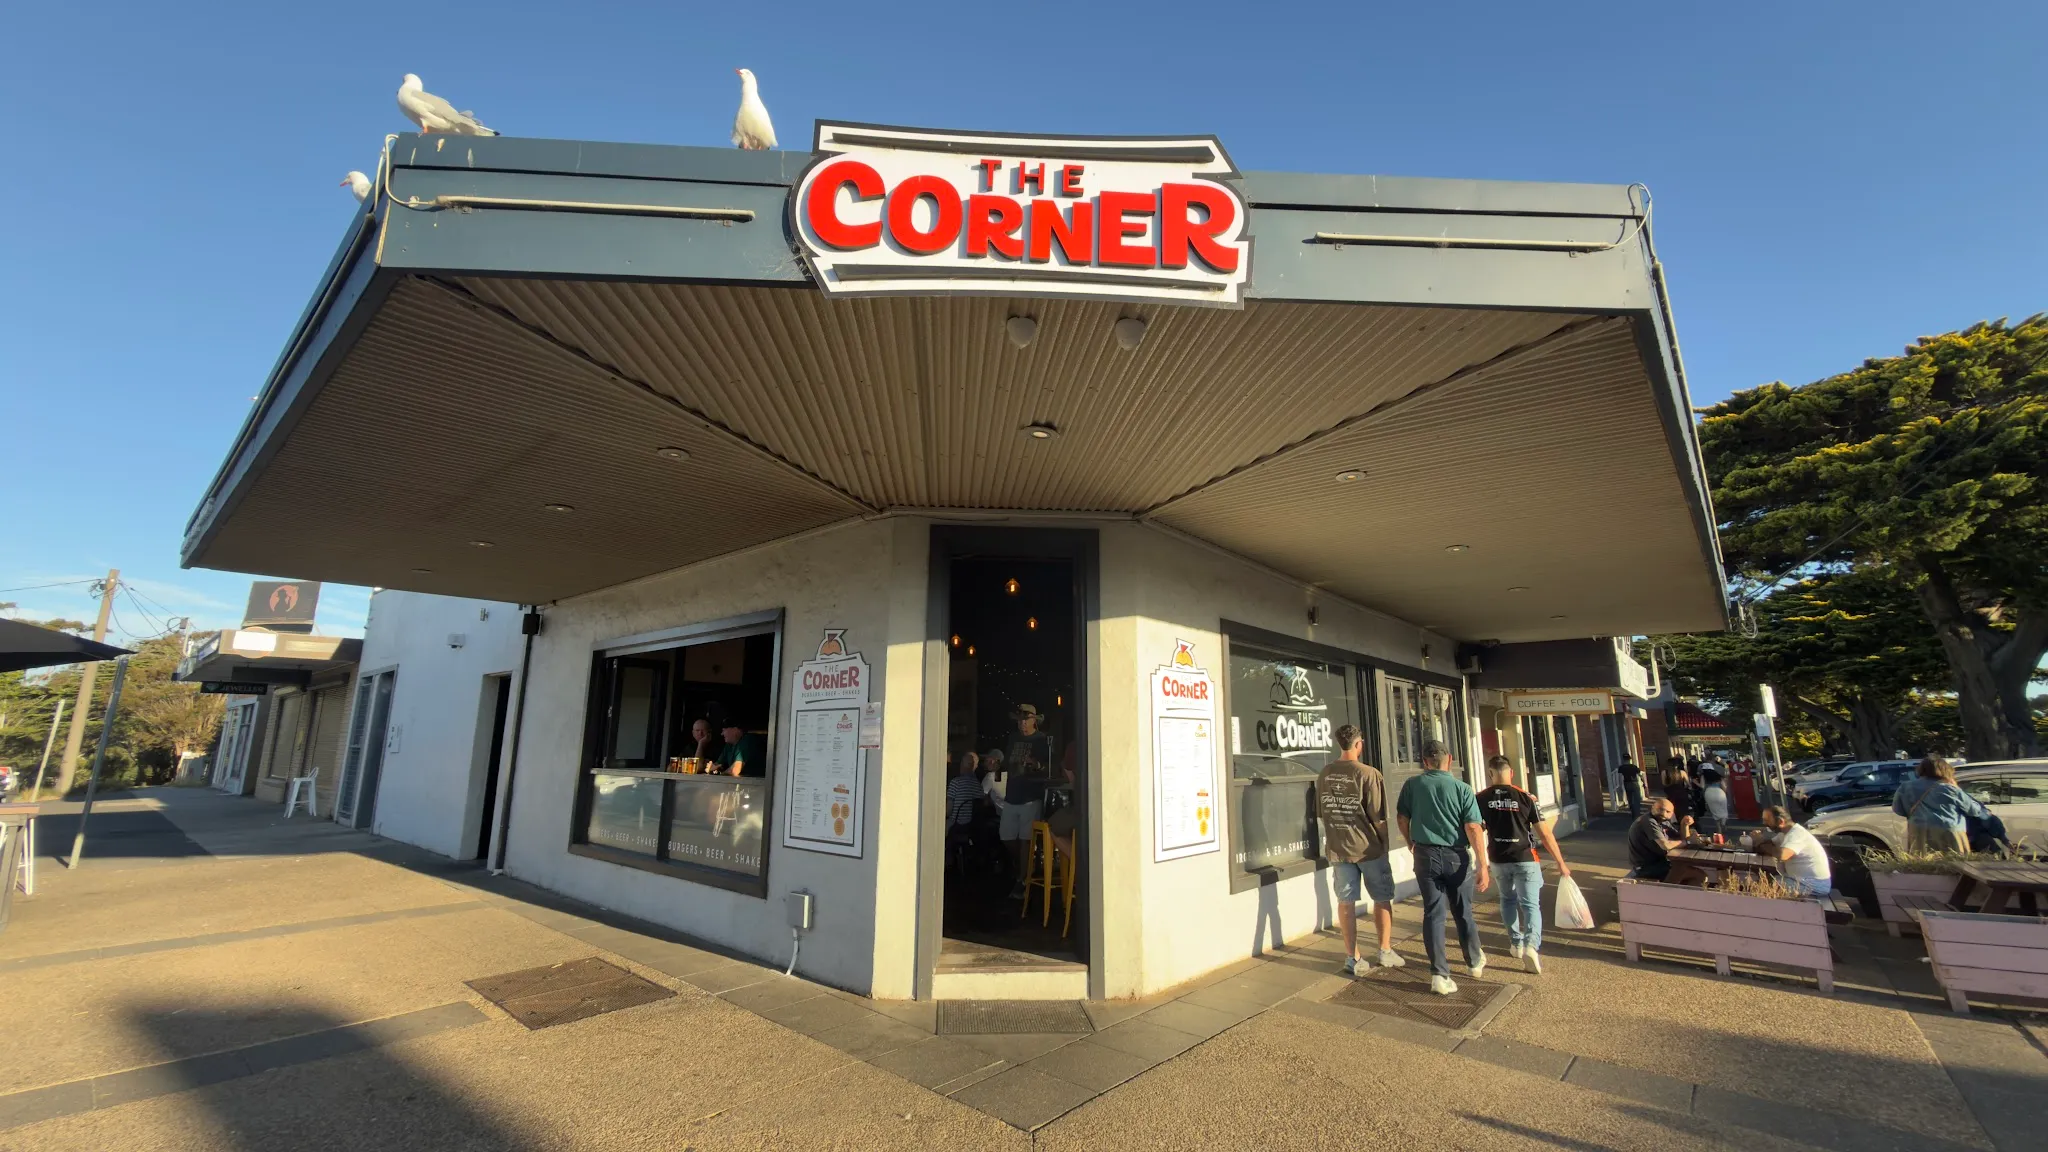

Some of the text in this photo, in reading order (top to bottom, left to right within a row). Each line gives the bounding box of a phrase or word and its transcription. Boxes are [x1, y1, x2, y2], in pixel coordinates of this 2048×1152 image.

[979, 159, 1085, 197] THE
[807, 160, 1240, 274] CORNER
[824, 664, 839, 673] THE
[803, 666, 860, 691] CORNER
[1162, 675, 1209, 701] CORNER
[1517, 699, 1555, 709] COFFEE
[1570, 698, 1601, 707] FOOD
[1297, 711, 1313, 724] THE
[1276, 714, 1333, 748] CORNER
[1487, 798, 1520, 809] aprilia
[615, 831, 630, 844] BEER
[1288, 839, 1310, 853] SHAKES
[667, 840, 698, 857] BURGERS
[705, 848, 724, 861] BEER
